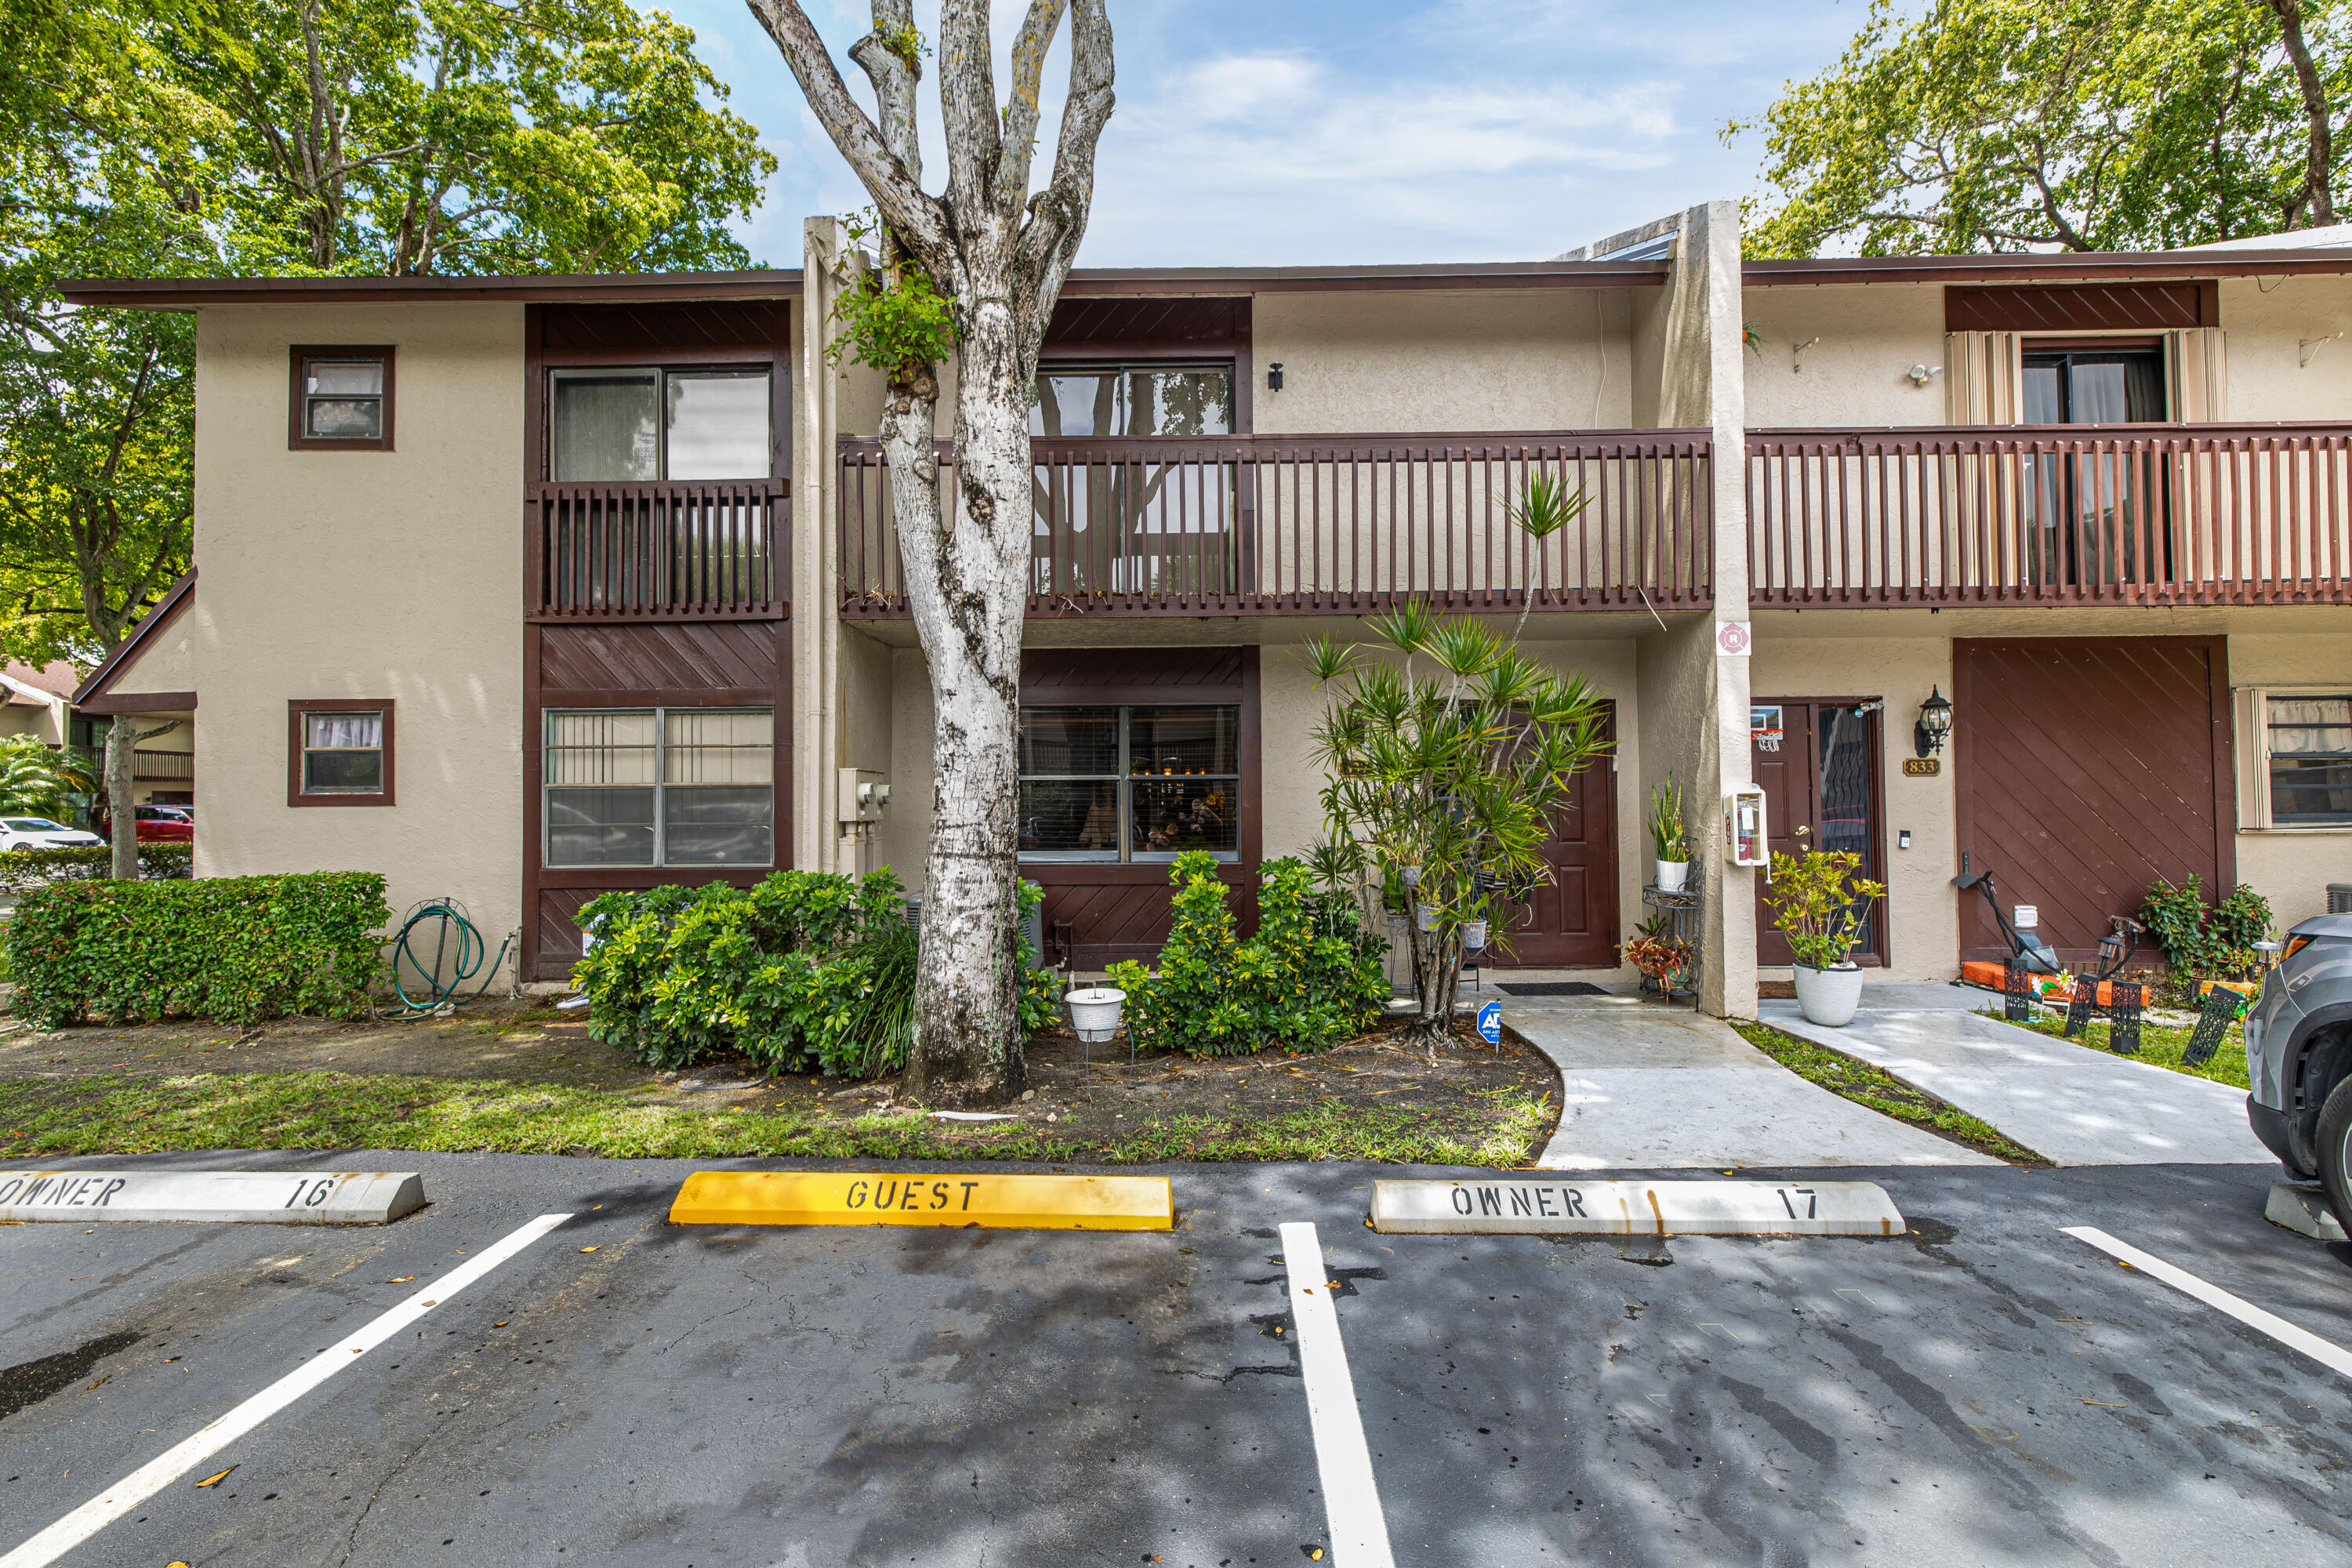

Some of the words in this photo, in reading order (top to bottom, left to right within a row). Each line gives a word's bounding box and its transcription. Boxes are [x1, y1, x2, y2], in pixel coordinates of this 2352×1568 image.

[1730, 634, 1738, 643] R
[1910, 761, 1934, 772] 833
[0, 1178, 125, 1206] OWNER
[285, 1179, 334, 1208] 16
[847, 1181, 978, 1210] GUEST
[1451, 1187, 1588, 1218] OWNER
[1777, 1189, 1816, 1219] 17
